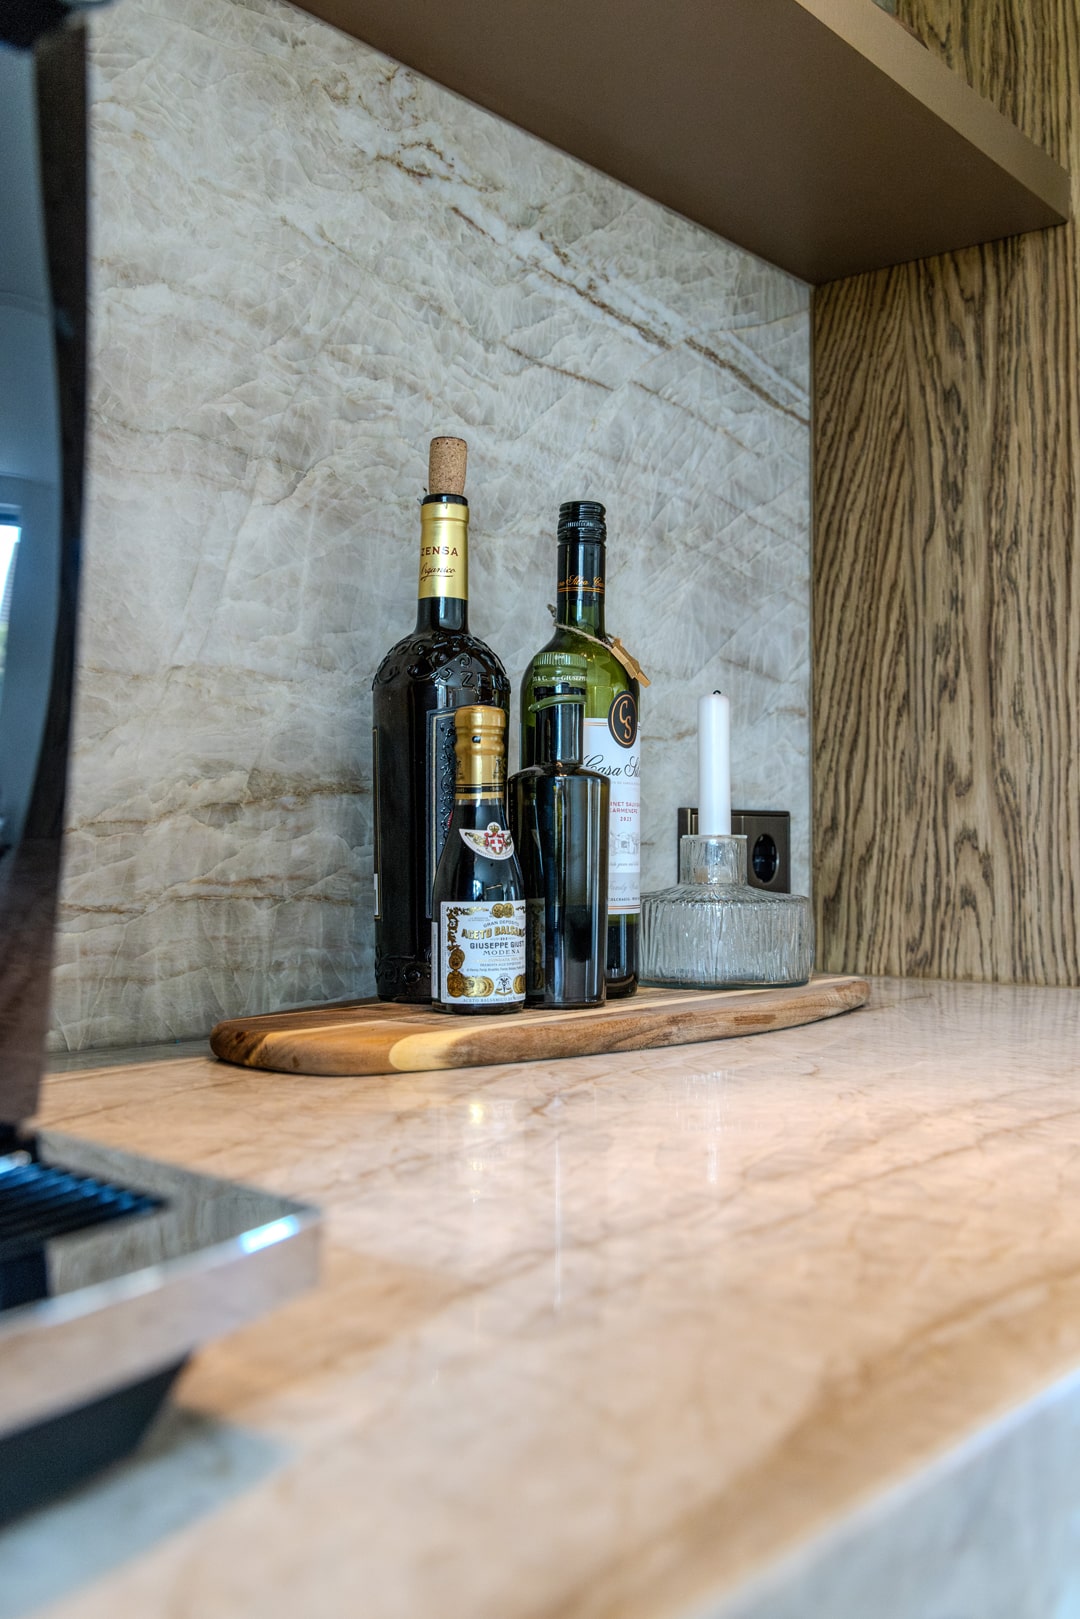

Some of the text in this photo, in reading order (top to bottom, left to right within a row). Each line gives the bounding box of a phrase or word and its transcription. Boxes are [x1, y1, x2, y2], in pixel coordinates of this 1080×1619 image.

[584, 754, 622, 777] Casa
[461, 928, 492, 941] ACETO
[469, 942, 509, 950] GIUSEPPE
[482, 948, 520, 956] MODENA
